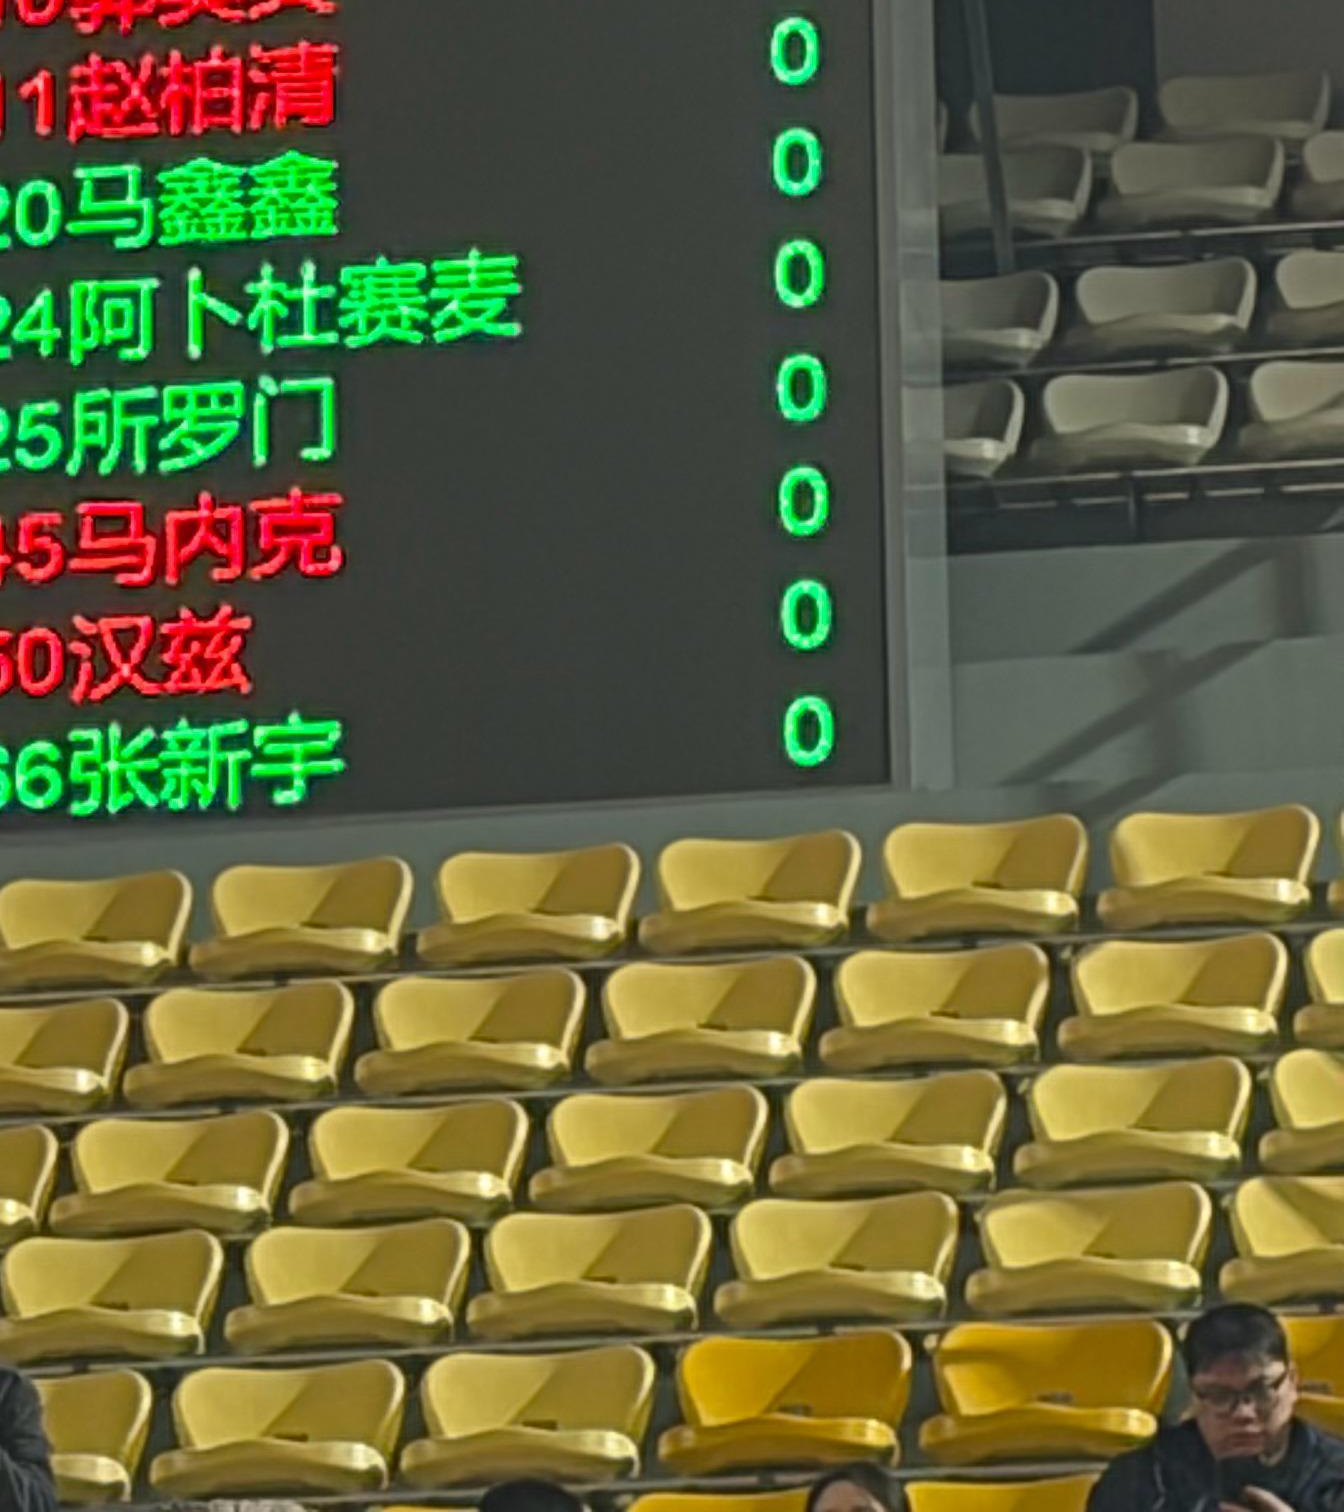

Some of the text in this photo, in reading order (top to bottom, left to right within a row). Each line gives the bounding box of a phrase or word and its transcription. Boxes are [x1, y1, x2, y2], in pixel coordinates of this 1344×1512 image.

[770, 17, 819, 85] 0
[772, 127, 821, 196] 0
[774, 239, 824, 308] 0
[776, 353, 826, 422] 0
[779, 465, 829, 536] 0
[780, 579, 831, 650] 0
[783, 695, 834, 766] 0
